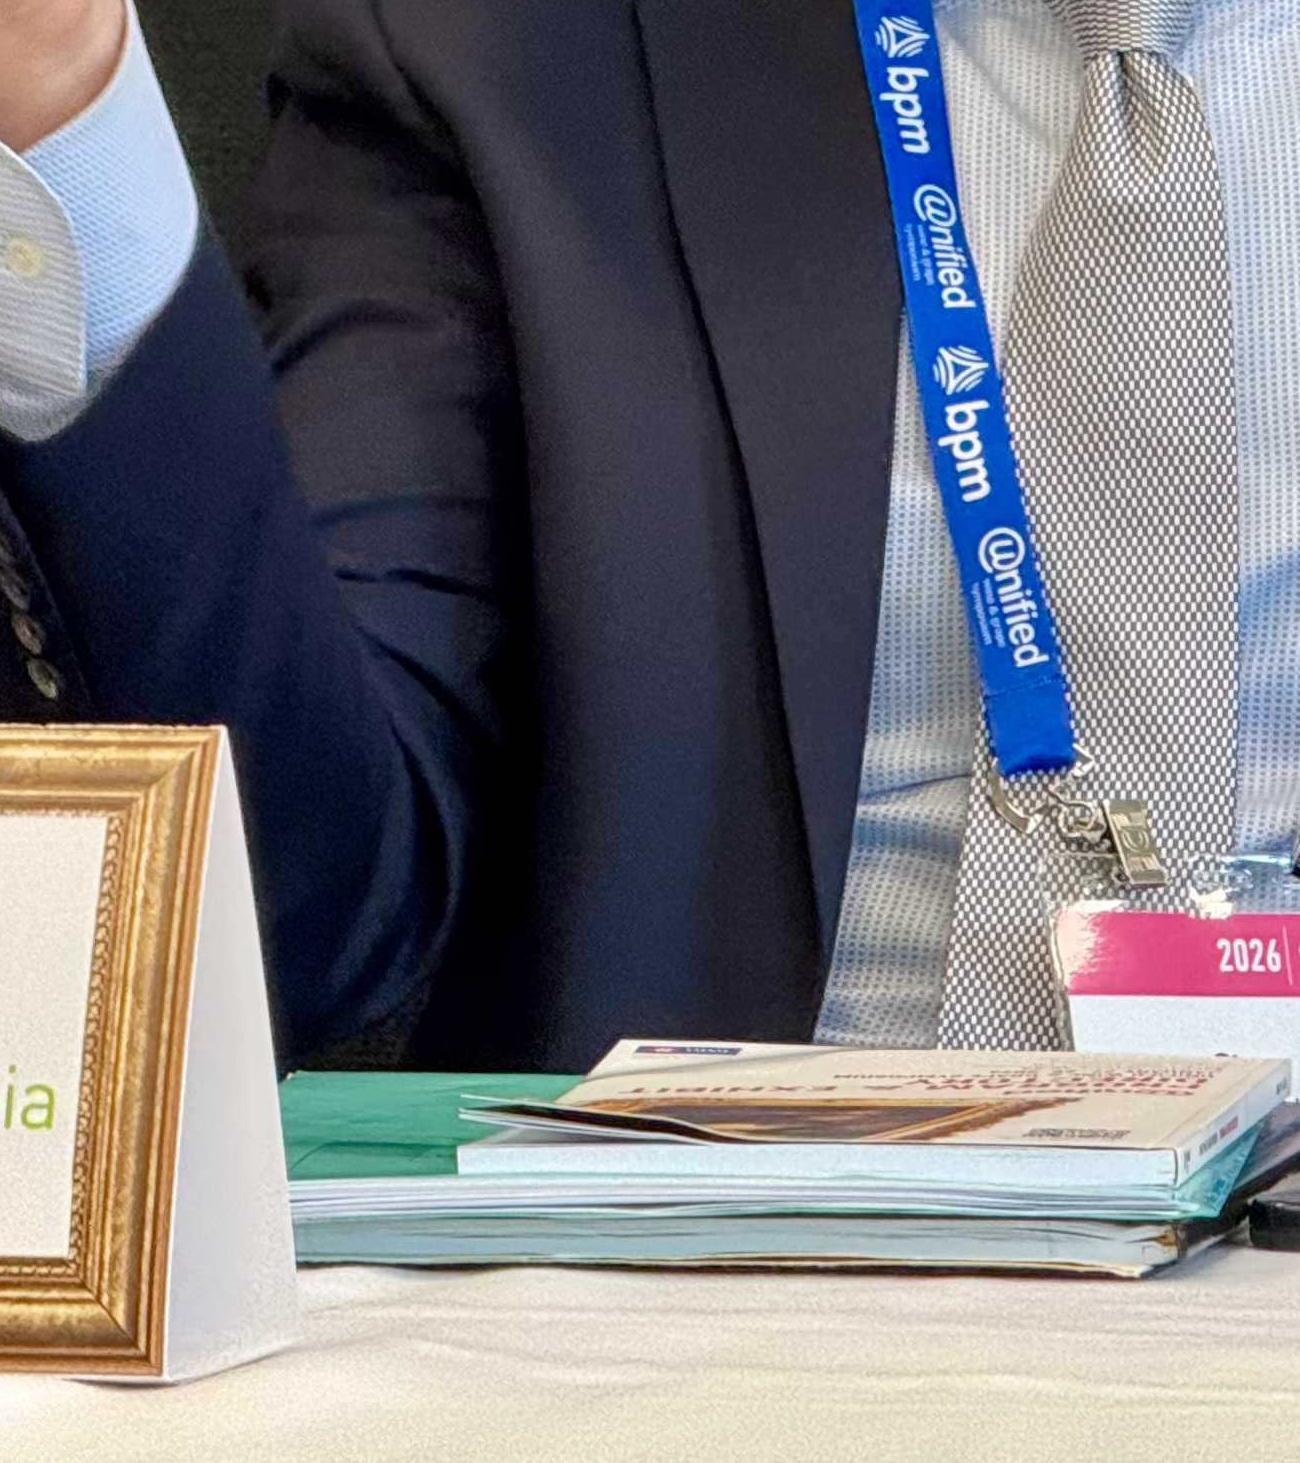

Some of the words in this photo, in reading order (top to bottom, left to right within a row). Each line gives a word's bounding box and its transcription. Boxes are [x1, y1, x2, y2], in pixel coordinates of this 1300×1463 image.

[879, 66, 930, 154] bpm
[937, 400, 991, 503] bpm
[1216, 937, 1282, 973] 2026
